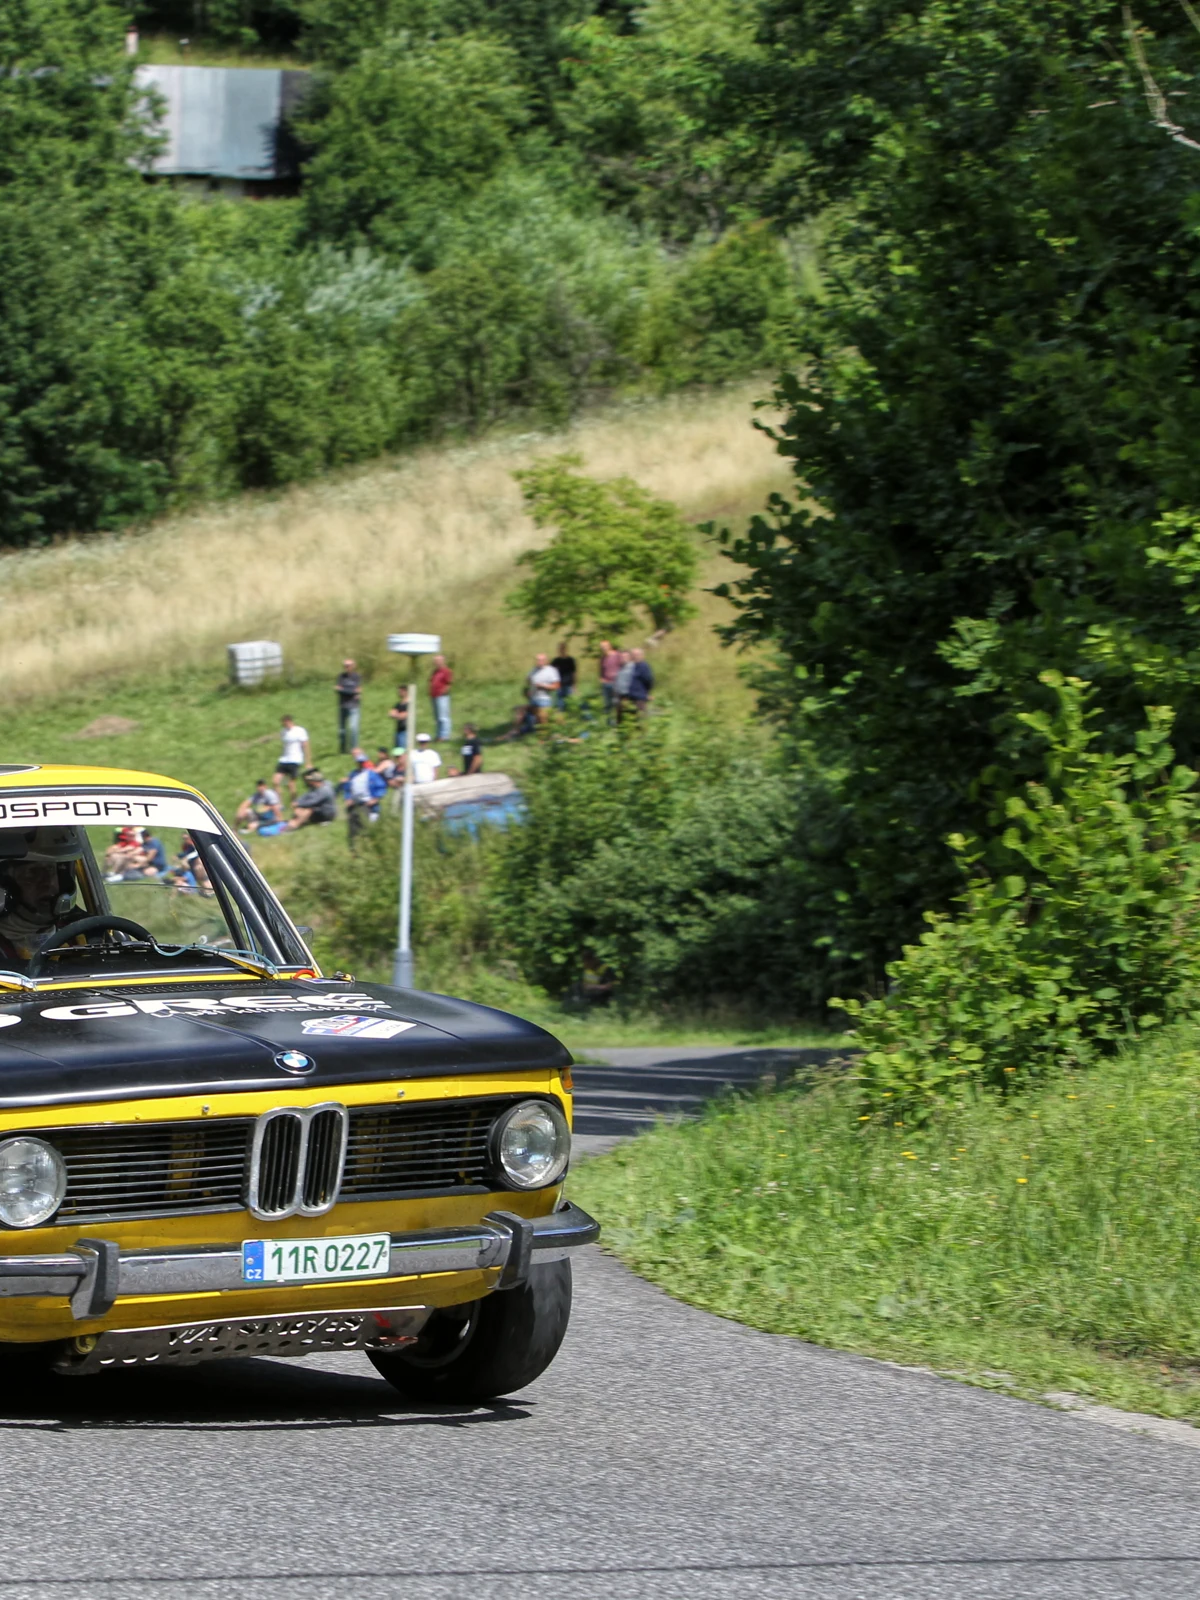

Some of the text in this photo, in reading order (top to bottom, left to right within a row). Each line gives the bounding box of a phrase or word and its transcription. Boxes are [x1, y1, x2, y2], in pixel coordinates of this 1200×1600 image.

[272, 1240, 387, 1275] 11R 0227
[246, 1268, 262, 1279] CZ
